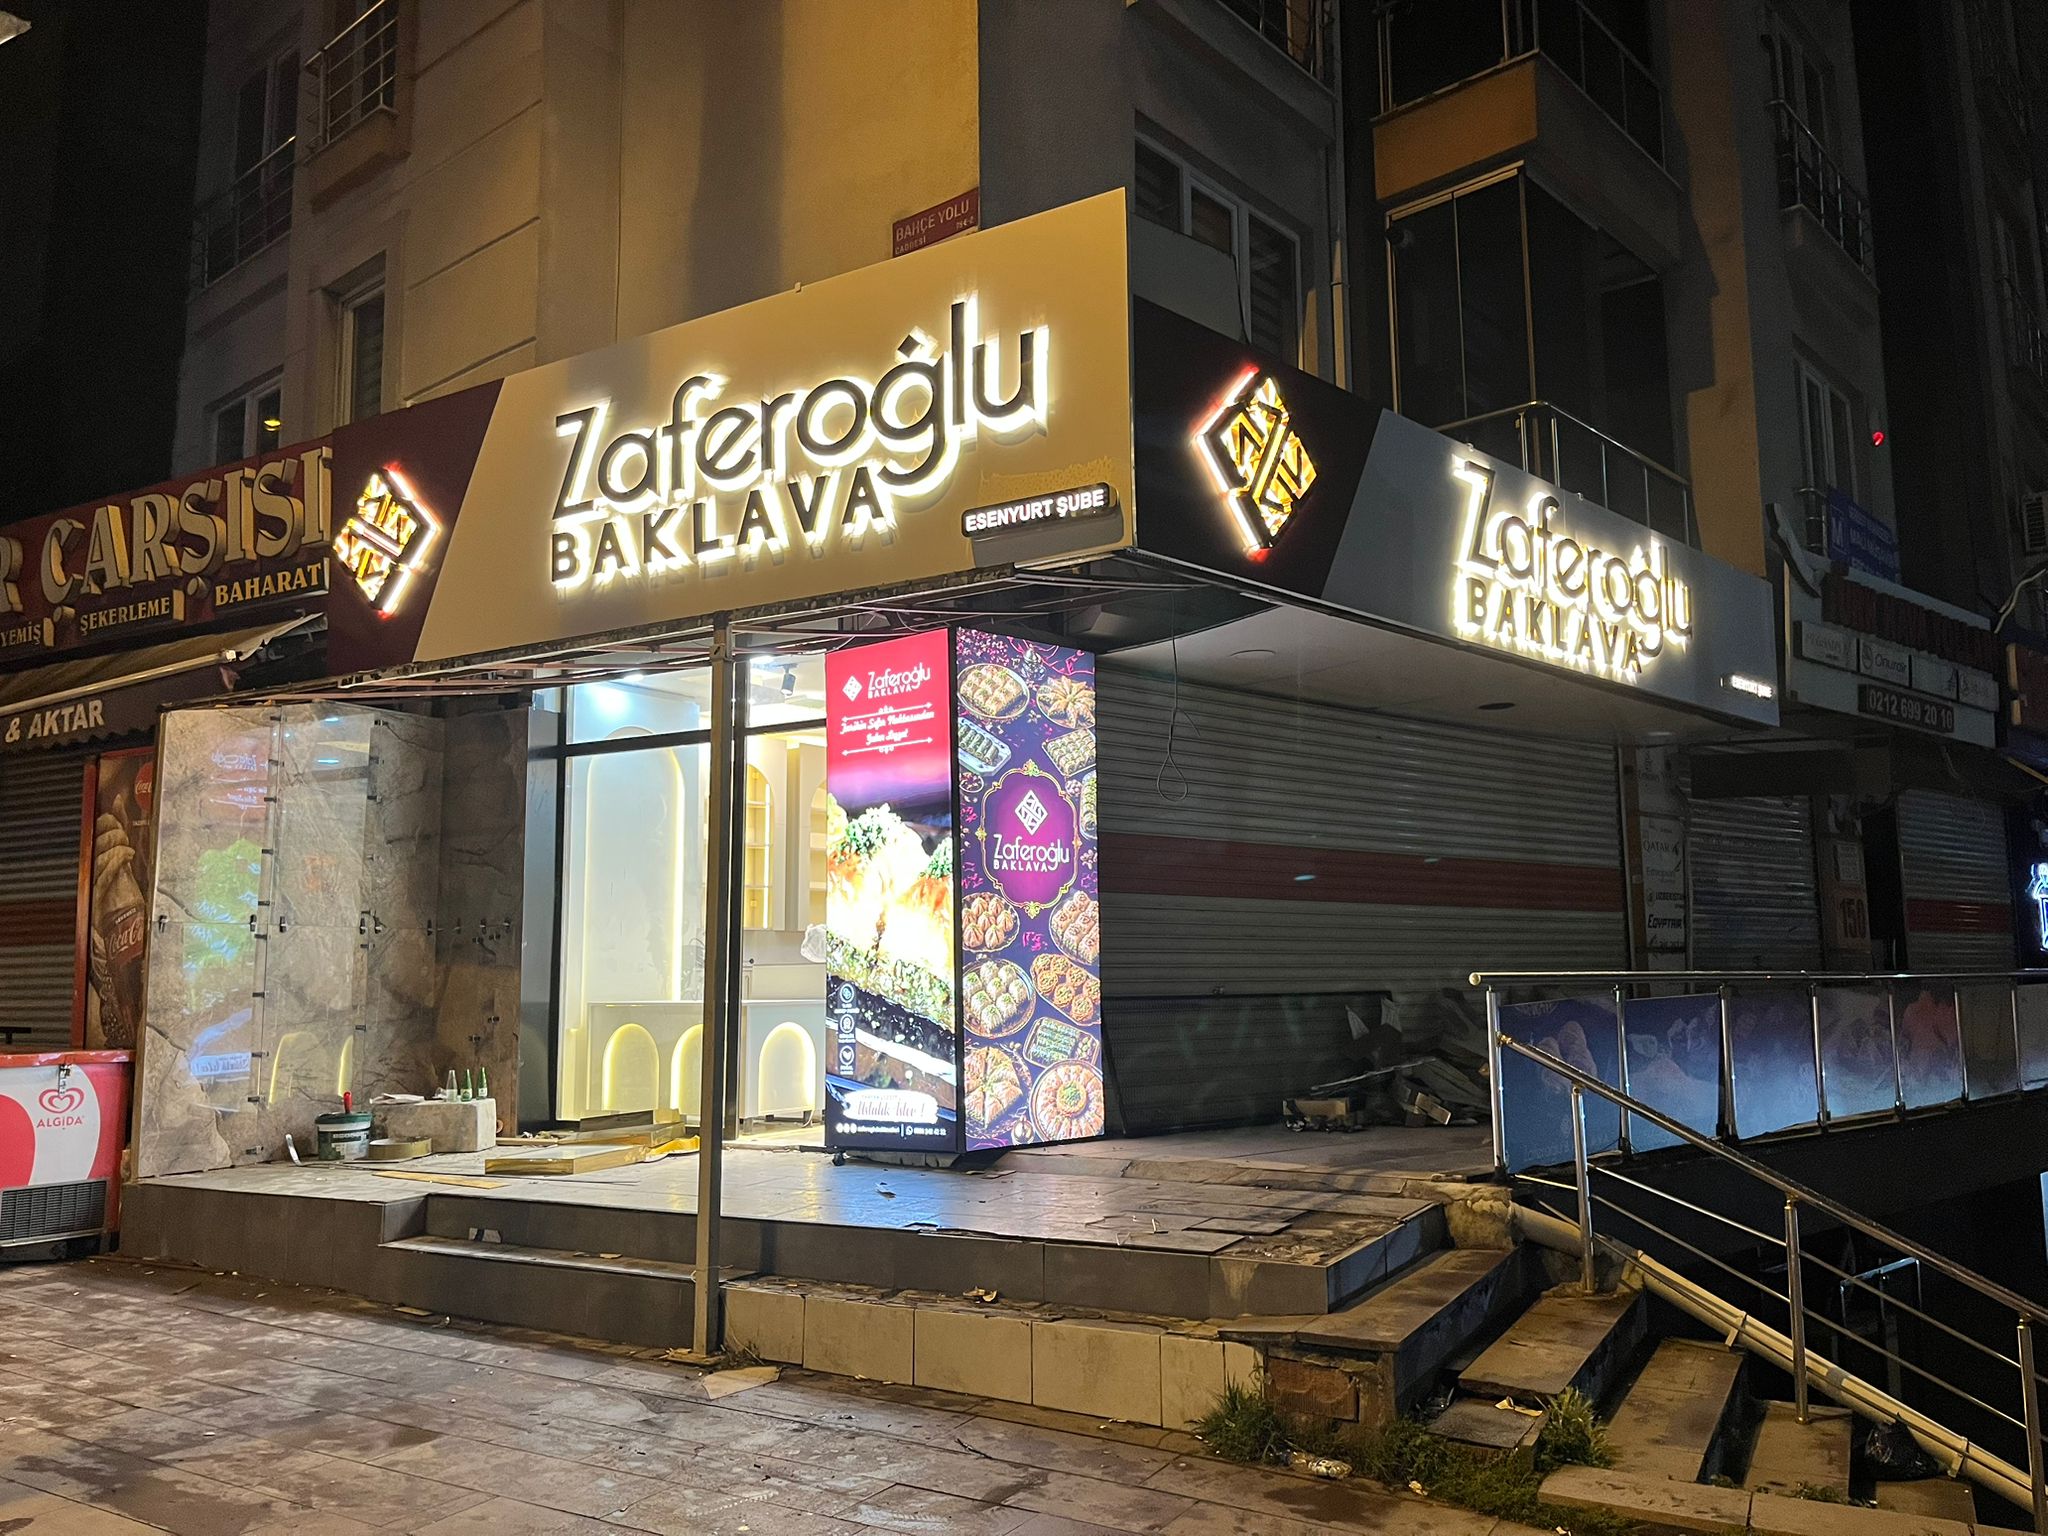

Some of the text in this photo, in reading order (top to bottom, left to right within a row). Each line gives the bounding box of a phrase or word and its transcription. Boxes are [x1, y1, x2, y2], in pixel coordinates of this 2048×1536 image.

[896, 213, 935, 241] BAHÇE
[938, 199, 970, 224] YOLU
[552, 467, 888, 583] BAKLAVA
[964, 489, 1105, 532] ESENYURT ŞUBE
[80, 597, 170, 635] ŞEKERLEME
[214, 562, 322, 608] BAHARAT
[1463, 576, 1644, 675] BAKLAVA
[867, 684, 912, 699] BAKLAVA
[1868, 688, 1898, 716] 0212
[1924, 705, 1938, 726] 20
[4, 700, 106, 744] & AKTAR
[993, 860, 1048, 873] BAKLAVA
[1643, 839, 1670, 854] QATAR
